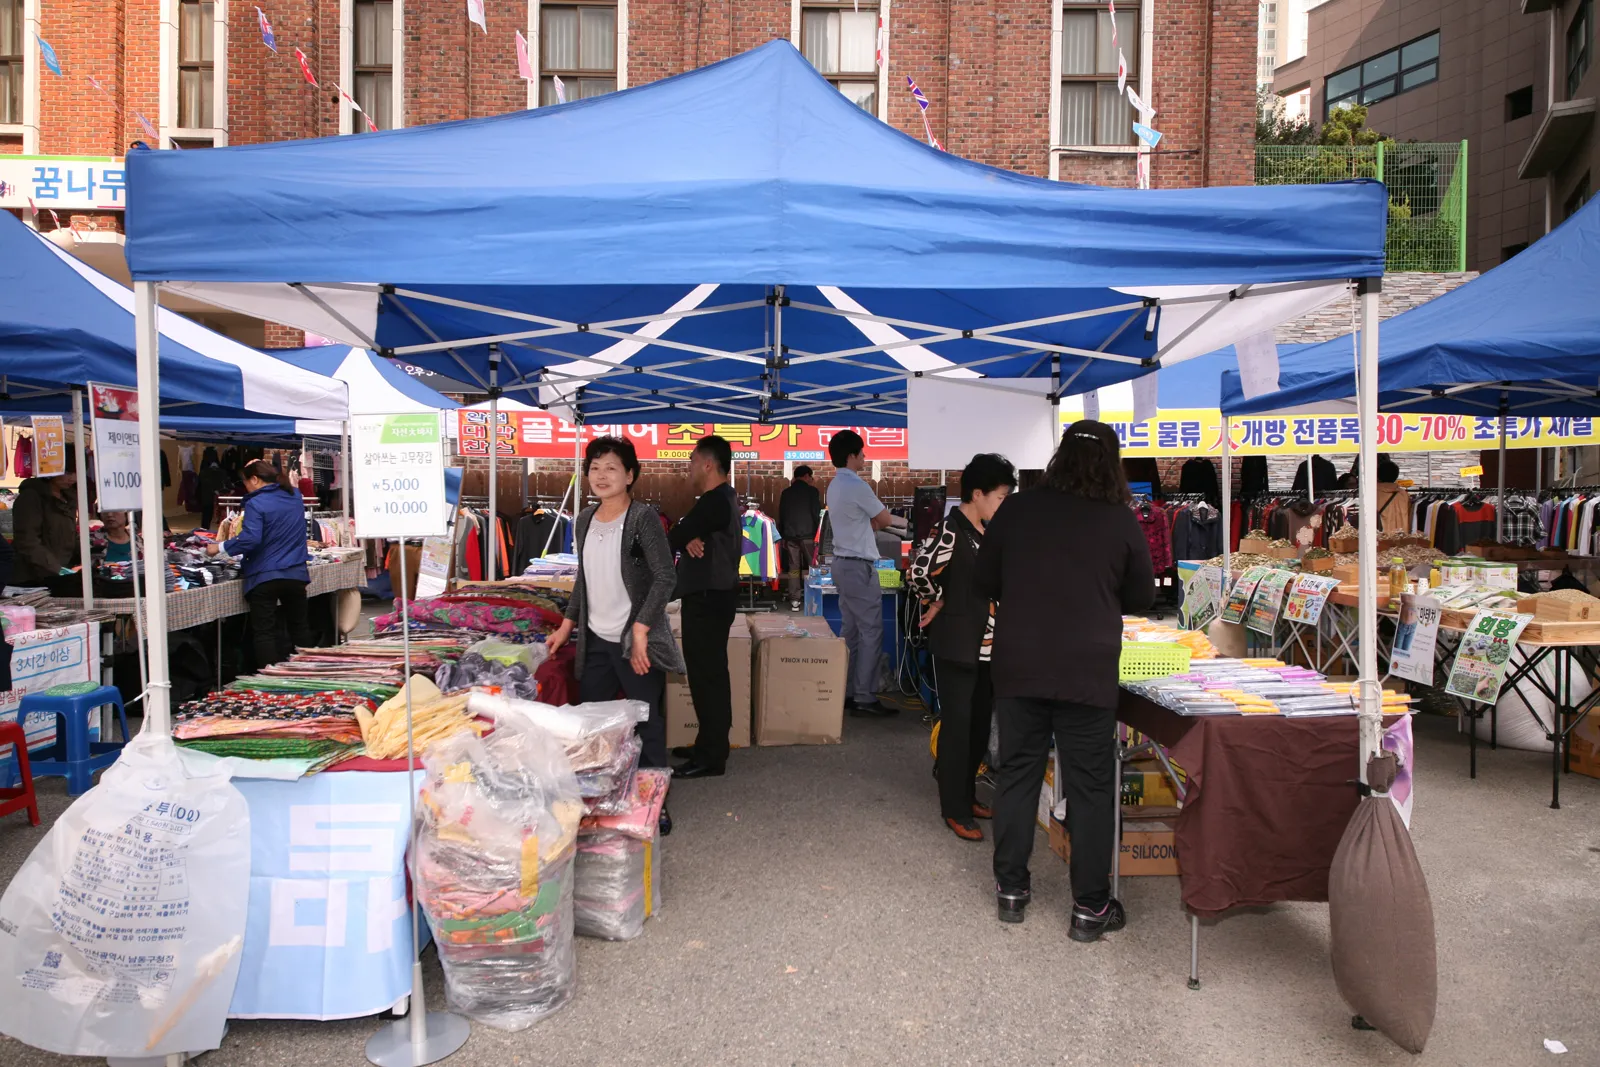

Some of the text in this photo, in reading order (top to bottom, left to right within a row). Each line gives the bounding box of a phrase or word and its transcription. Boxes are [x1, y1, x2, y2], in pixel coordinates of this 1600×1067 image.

[1158, 421, 1200, 448] 물류
[1293, 417, 1360, 446] 전품목
[400, 451, 432, 465] 고무장갑
[1474, 616, 1518, 638] 회향
[16, 646, 71, 672] 3시간 이상
